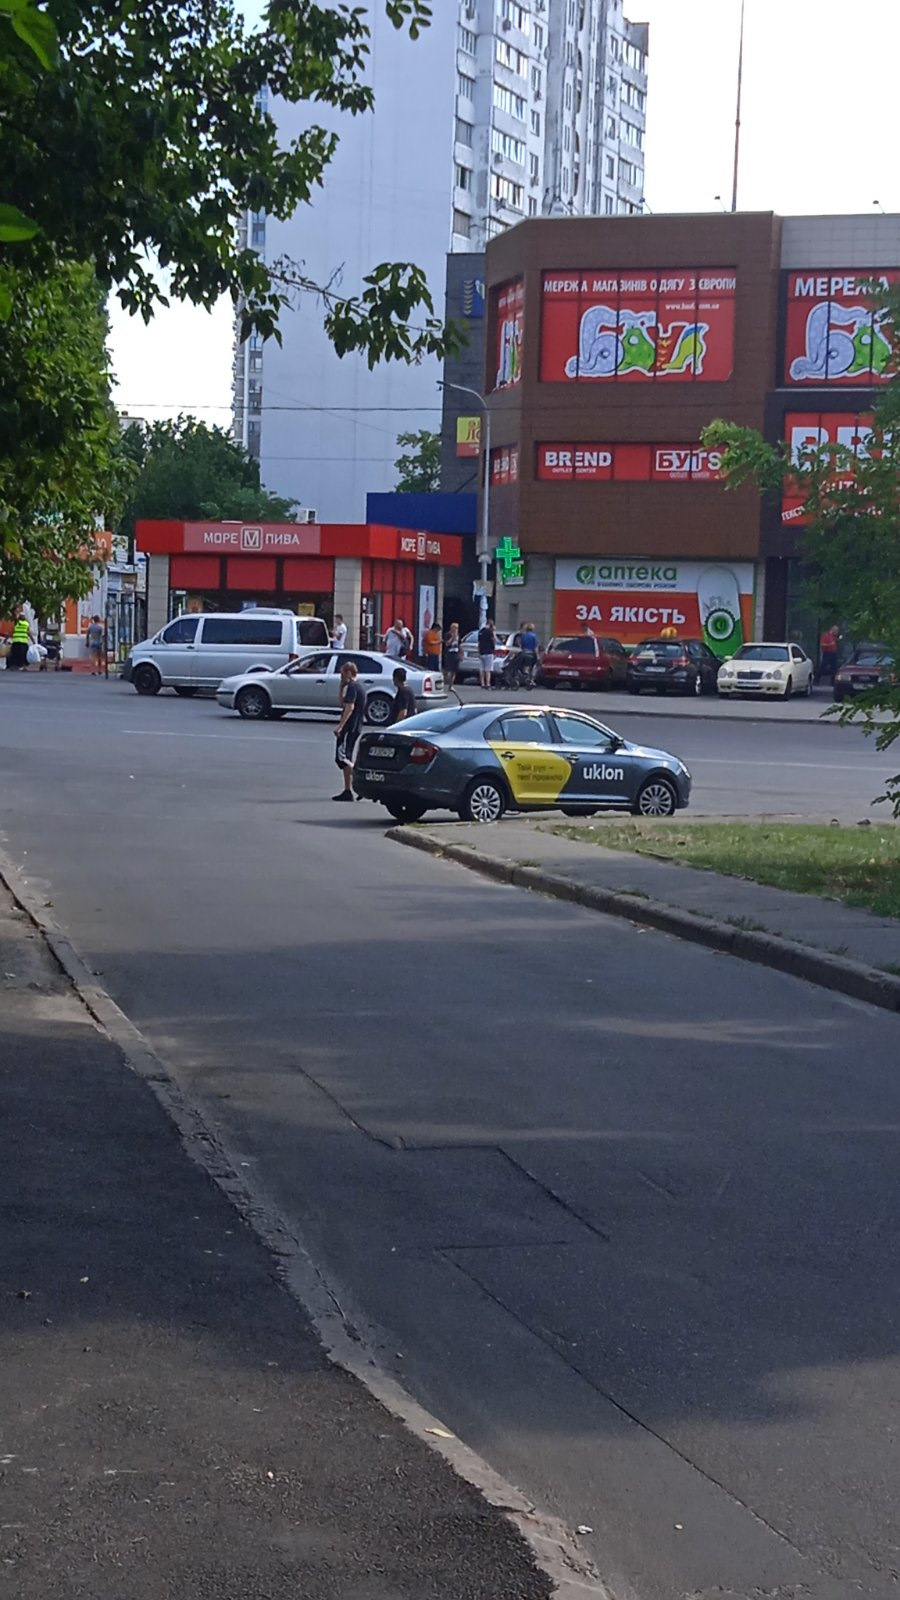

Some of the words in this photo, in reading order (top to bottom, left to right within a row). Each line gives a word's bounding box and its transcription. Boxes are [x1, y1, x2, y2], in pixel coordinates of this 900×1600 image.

[543, 280, 588, 293] МЕРЕЖА
[592, 279, 647, 292] МАГАЗИНІВ
[651, 278, 685, 293] ОДЯГУ
[698, 277, 737, 291] ЄВРОПИ
[545, 451, 612, 467] BREND
[204, 532, 238, 544] МОРЕ
[265, 534, 300, 545] ПИВА
[598, 565, 677, 581] аптека
[575, 605, 602, 621] ЗА
[610, 606, 686, 625] ЯКІСТЬ
[583, 764, 624, 781] uklon
